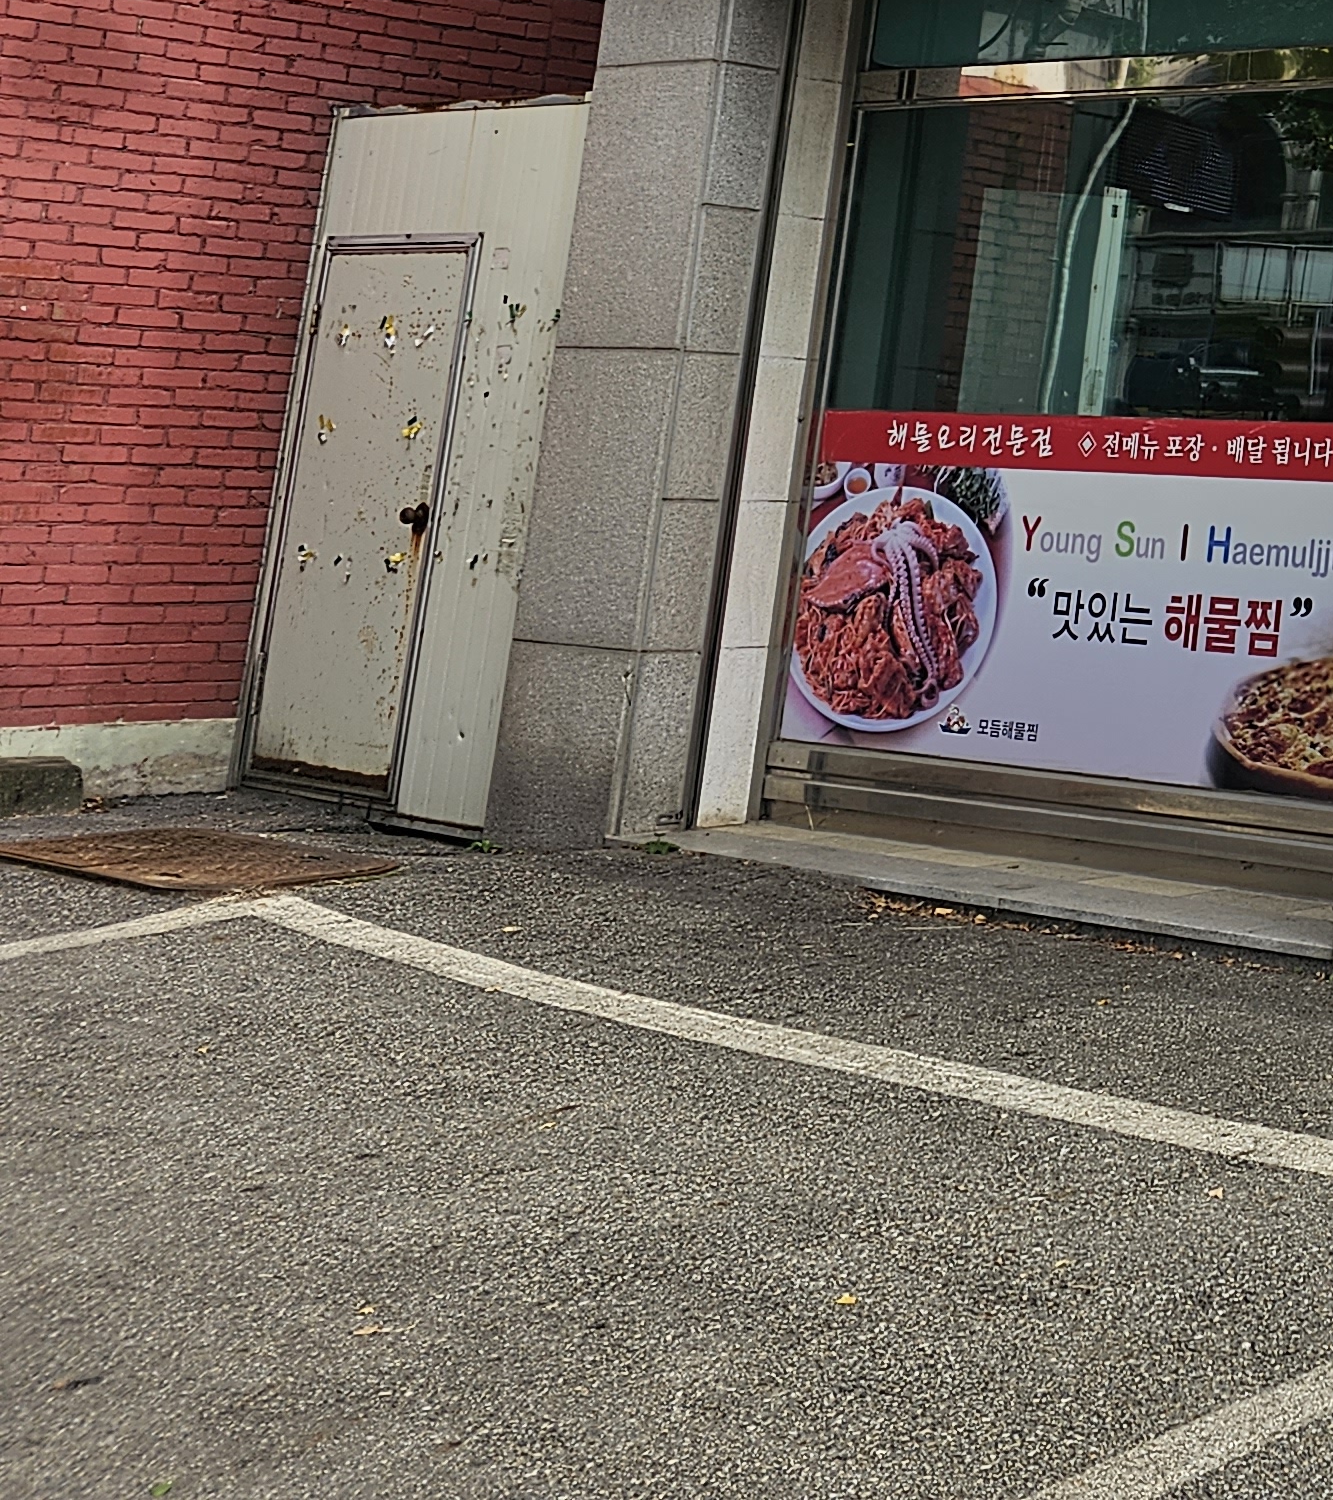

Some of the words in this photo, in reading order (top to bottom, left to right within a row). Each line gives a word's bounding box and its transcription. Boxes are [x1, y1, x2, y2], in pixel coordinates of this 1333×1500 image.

[886, 419, 1054, 457] 해물요리전문점
[1102, 433, 1160, 461] 전메뉴
[1165, 434, 1205, 462] 포장
[1227, 436, 1268, 464] 배달
[1272, 438, 1333, 468] 됩니다
[1023, 515, 1102, 563] Young
[1115, 521, 1165, 560] Sun
[977, 719, 1038, 742] 모듬해물찜
